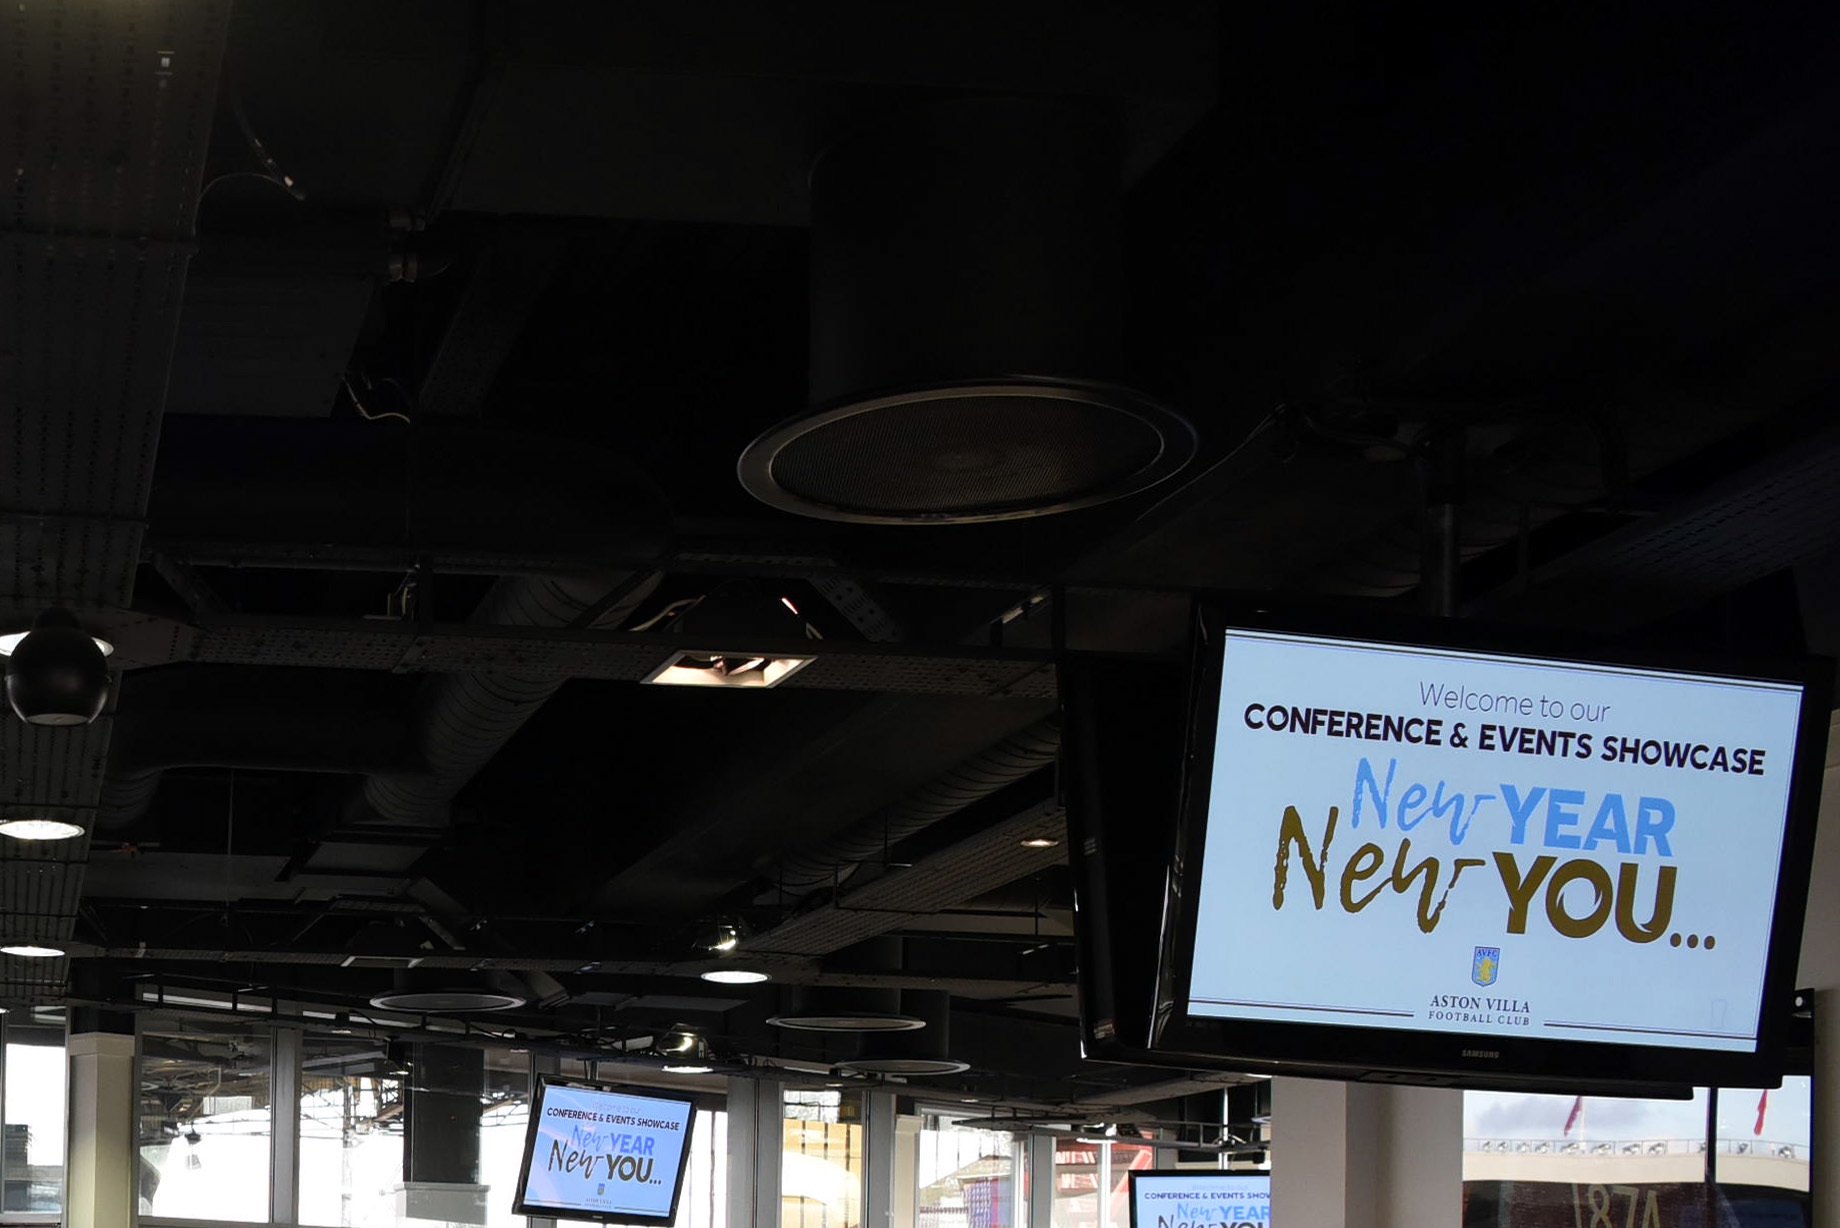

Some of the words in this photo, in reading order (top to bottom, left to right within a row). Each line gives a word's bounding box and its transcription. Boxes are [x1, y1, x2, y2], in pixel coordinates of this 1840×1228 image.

[1420, 680, 1533, 716] Welcome
[1540, 698, 1563, 719] to
[1570, 702, 1611, 723] our
[1244, 703, 1442, 746] CONFERENCE
[1449, 722, 1469, 749] &
[1478, 724, 1592, 760] EVENTS
[1601, 735, 1766, 776] SHOWCASE
[1351, 757, 1496, 845] New
[1499, 783, 1676, 857] YEAR
[1272, 805, 1486, 934] New
[1492, 851, 1716, 950] YOU...
[1476, 949, 1497, 957] AVFC
[1430, 994, 1481, 1010] ASTON
[1486, 998, 1530, 1013] VILLA
[1428, 1011, 1493, 1023] FOOTBALL
[1497, 1015, 1530, 1026] CLUB
[1462, 1050, 1500, 1059] SAMSUNG
[546, 1107, 598, 1121] CONFERENCE
[599, 1113, 605, 1122] &
[606, 1113, 636, 1126] EVENTS
[637, 1118, 680, 1131] SHOWCASE
[572, 1125, 609, 1151] New
[611, 1133, 655, 1156] YEAR
[548, 1139, 604, 1179] New
[607, 1154, 662, 1185] YOU...
[1144, 1192, 1200, 1200] CONFERENCE
[1210, 1192, 1244, 1200] EVENTS
[1177, 1202, 1218, 1221] New
